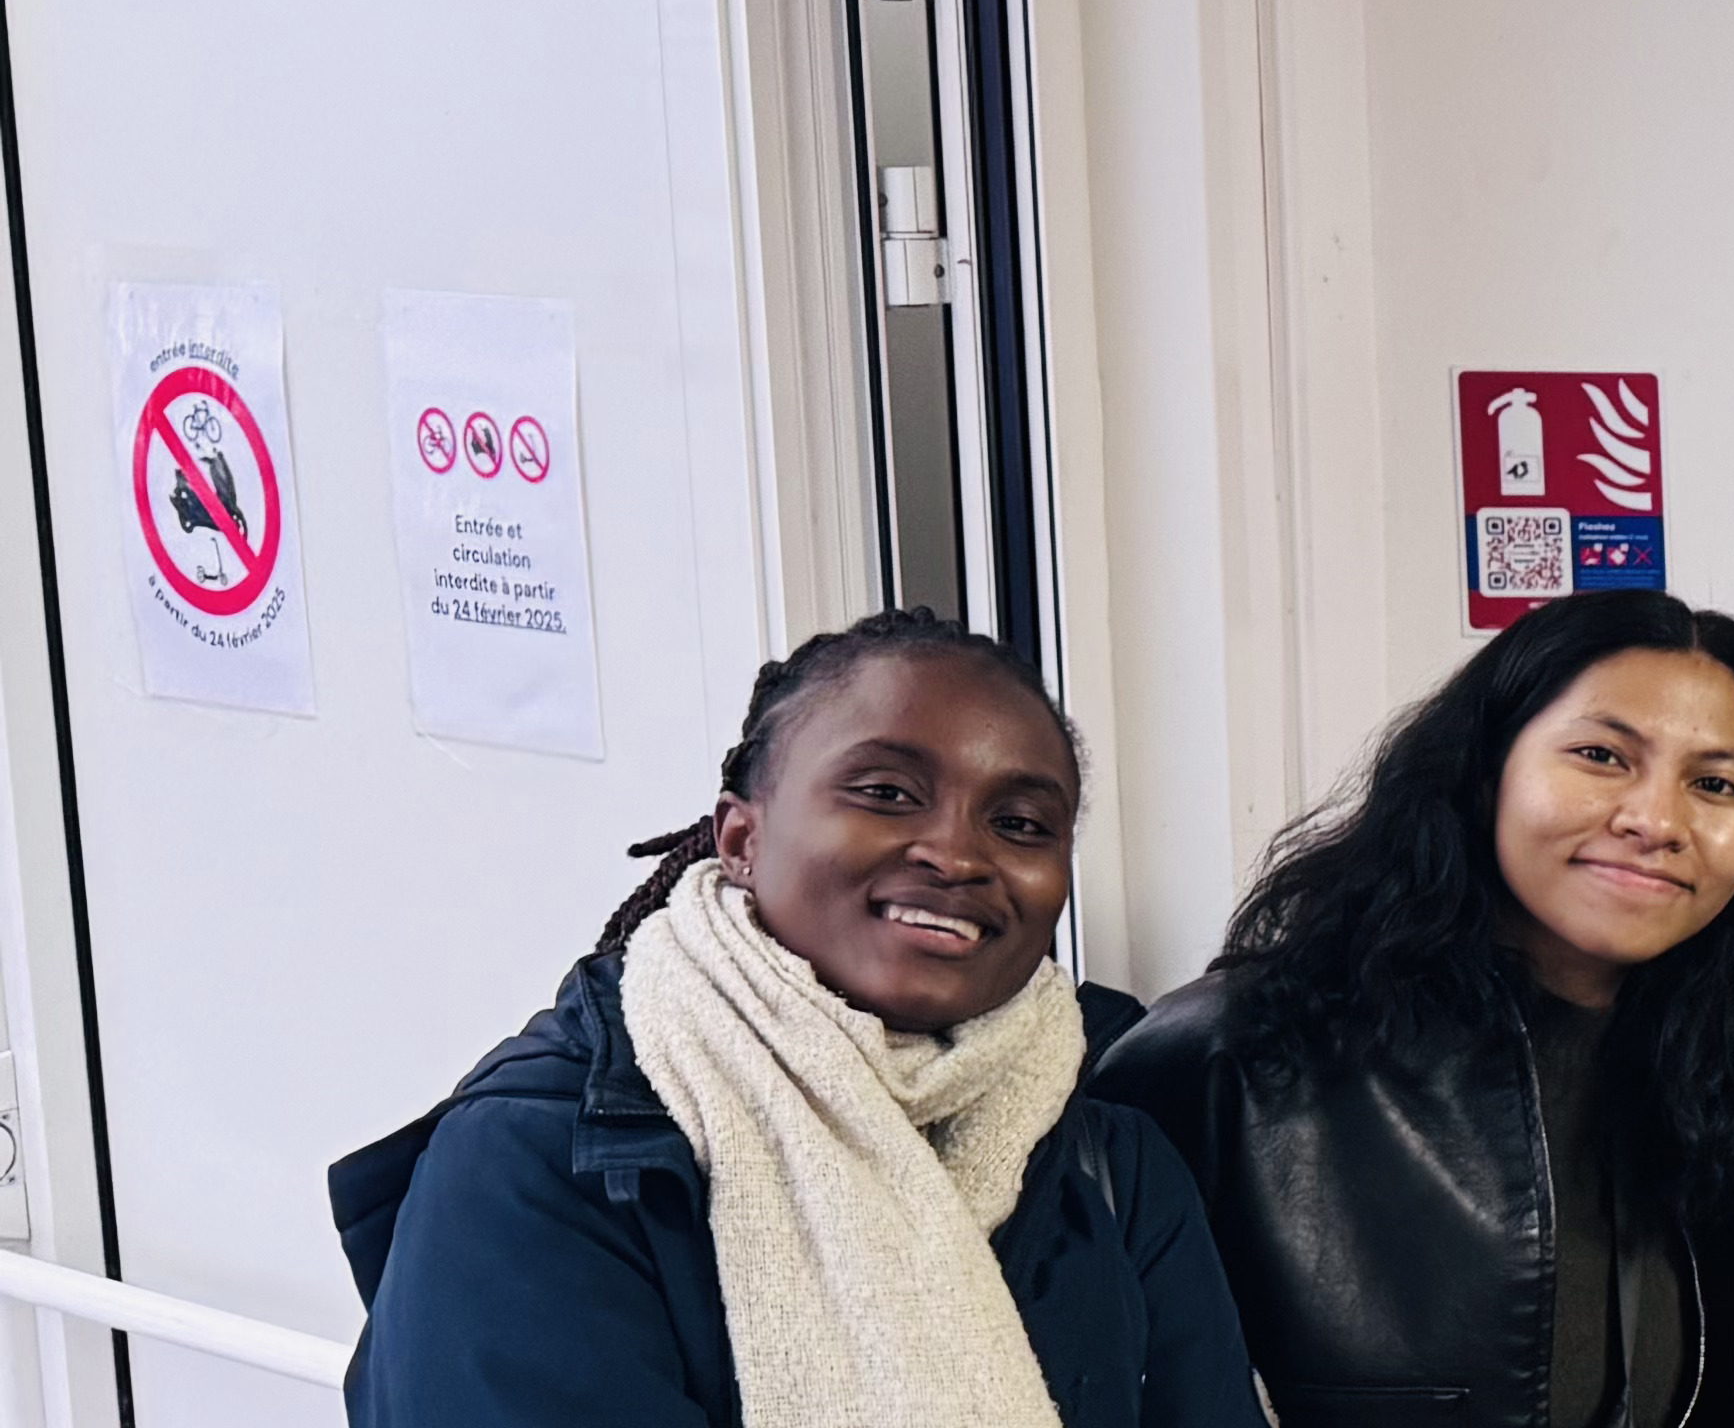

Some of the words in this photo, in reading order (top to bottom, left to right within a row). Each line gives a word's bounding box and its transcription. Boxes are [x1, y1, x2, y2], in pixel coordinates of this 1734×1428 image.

[150, 341, 186, 372] entrée
[188, 339, 239, 380] interdite
[455, 514, 503, 538] Entrée
[507, 523, 523, 540] et
[453, 543, 531, 569] circulation
[434, 568, 497, 594] interdite
[502, 577, 510, 596] à
[514, 581, 555, 602] partir
[154, 588, 188, 627] partir
[191, 624, 207, 642] du
[209, 630, 225, 647] 24
[261, 587, 286, 629] 2025
[431, 596, 449, 616] du
[453, 599, 471, 620] 24
[474, 601, 521, 628] février
